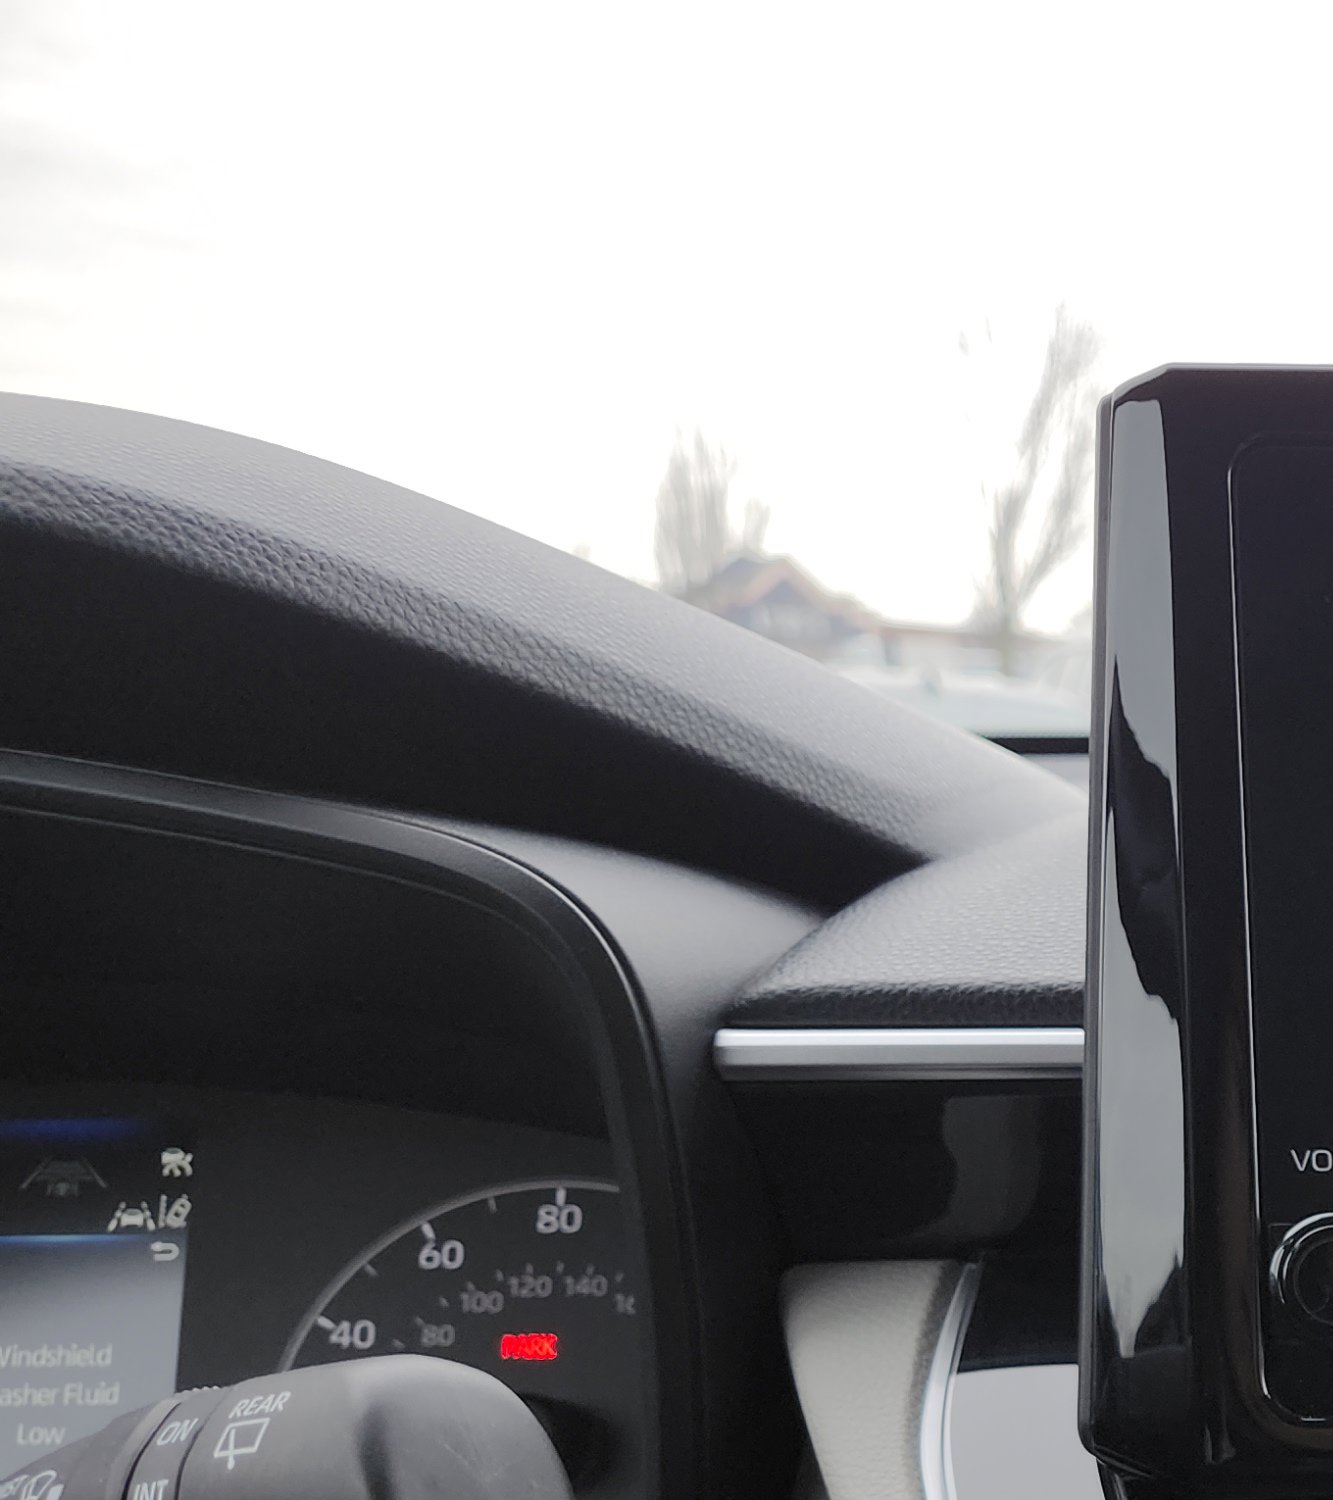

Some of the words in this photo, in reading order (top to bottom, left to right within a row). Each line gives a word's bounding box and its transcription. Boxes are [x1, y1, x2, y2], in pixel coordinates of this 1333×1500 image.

[535, 1204, 583, 1234] 80
[418, 1239, 465, 1270] 60
[507, 1275, 553, 1298] 120
[564, 1275, 609, 1298] 140
[460, 1291, 505, 1314] 100
[328, 1318, 376, 1350] 40
[420, 1323, 456, 1348] 80
[63, 1381, 120, 1407] Fluid
[228, 1391, 292, 1419] REAR
[17, 1422, 66, 1446] Low
[156, 1418, 198, 1446] ON
